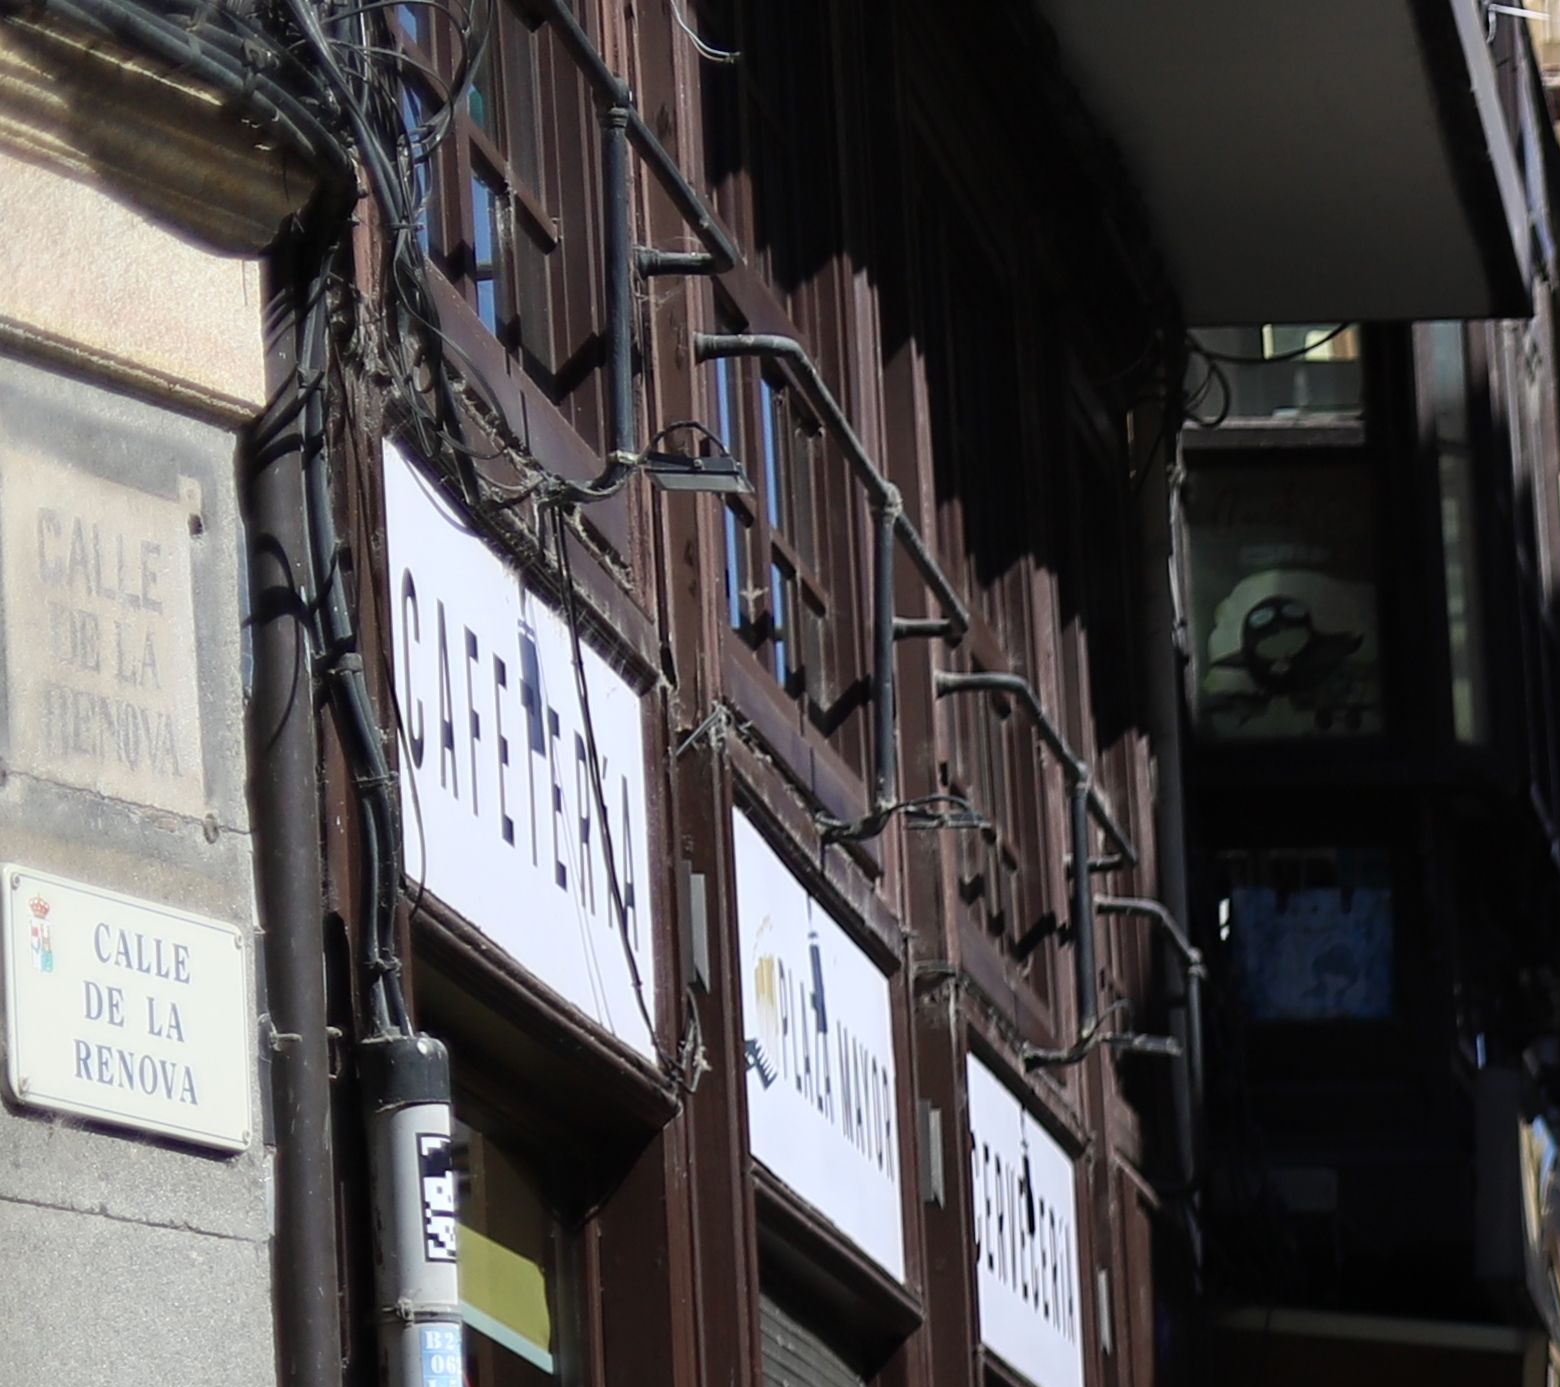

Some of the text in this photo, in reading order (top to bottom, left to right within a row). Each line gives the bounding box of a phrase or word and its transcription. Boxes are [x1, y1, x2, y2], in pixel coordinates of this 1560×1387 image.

[36, 506, 165, 616] CALLE
[114, 620, 162, 691] LA
[94, 922, 191, 984] CALLE
[83, 979, 186, 1042] DE LA
[73, 1038, 199, 1106] RENOVA
[778, 957, 896, 1184] PLAZA MAYOR
